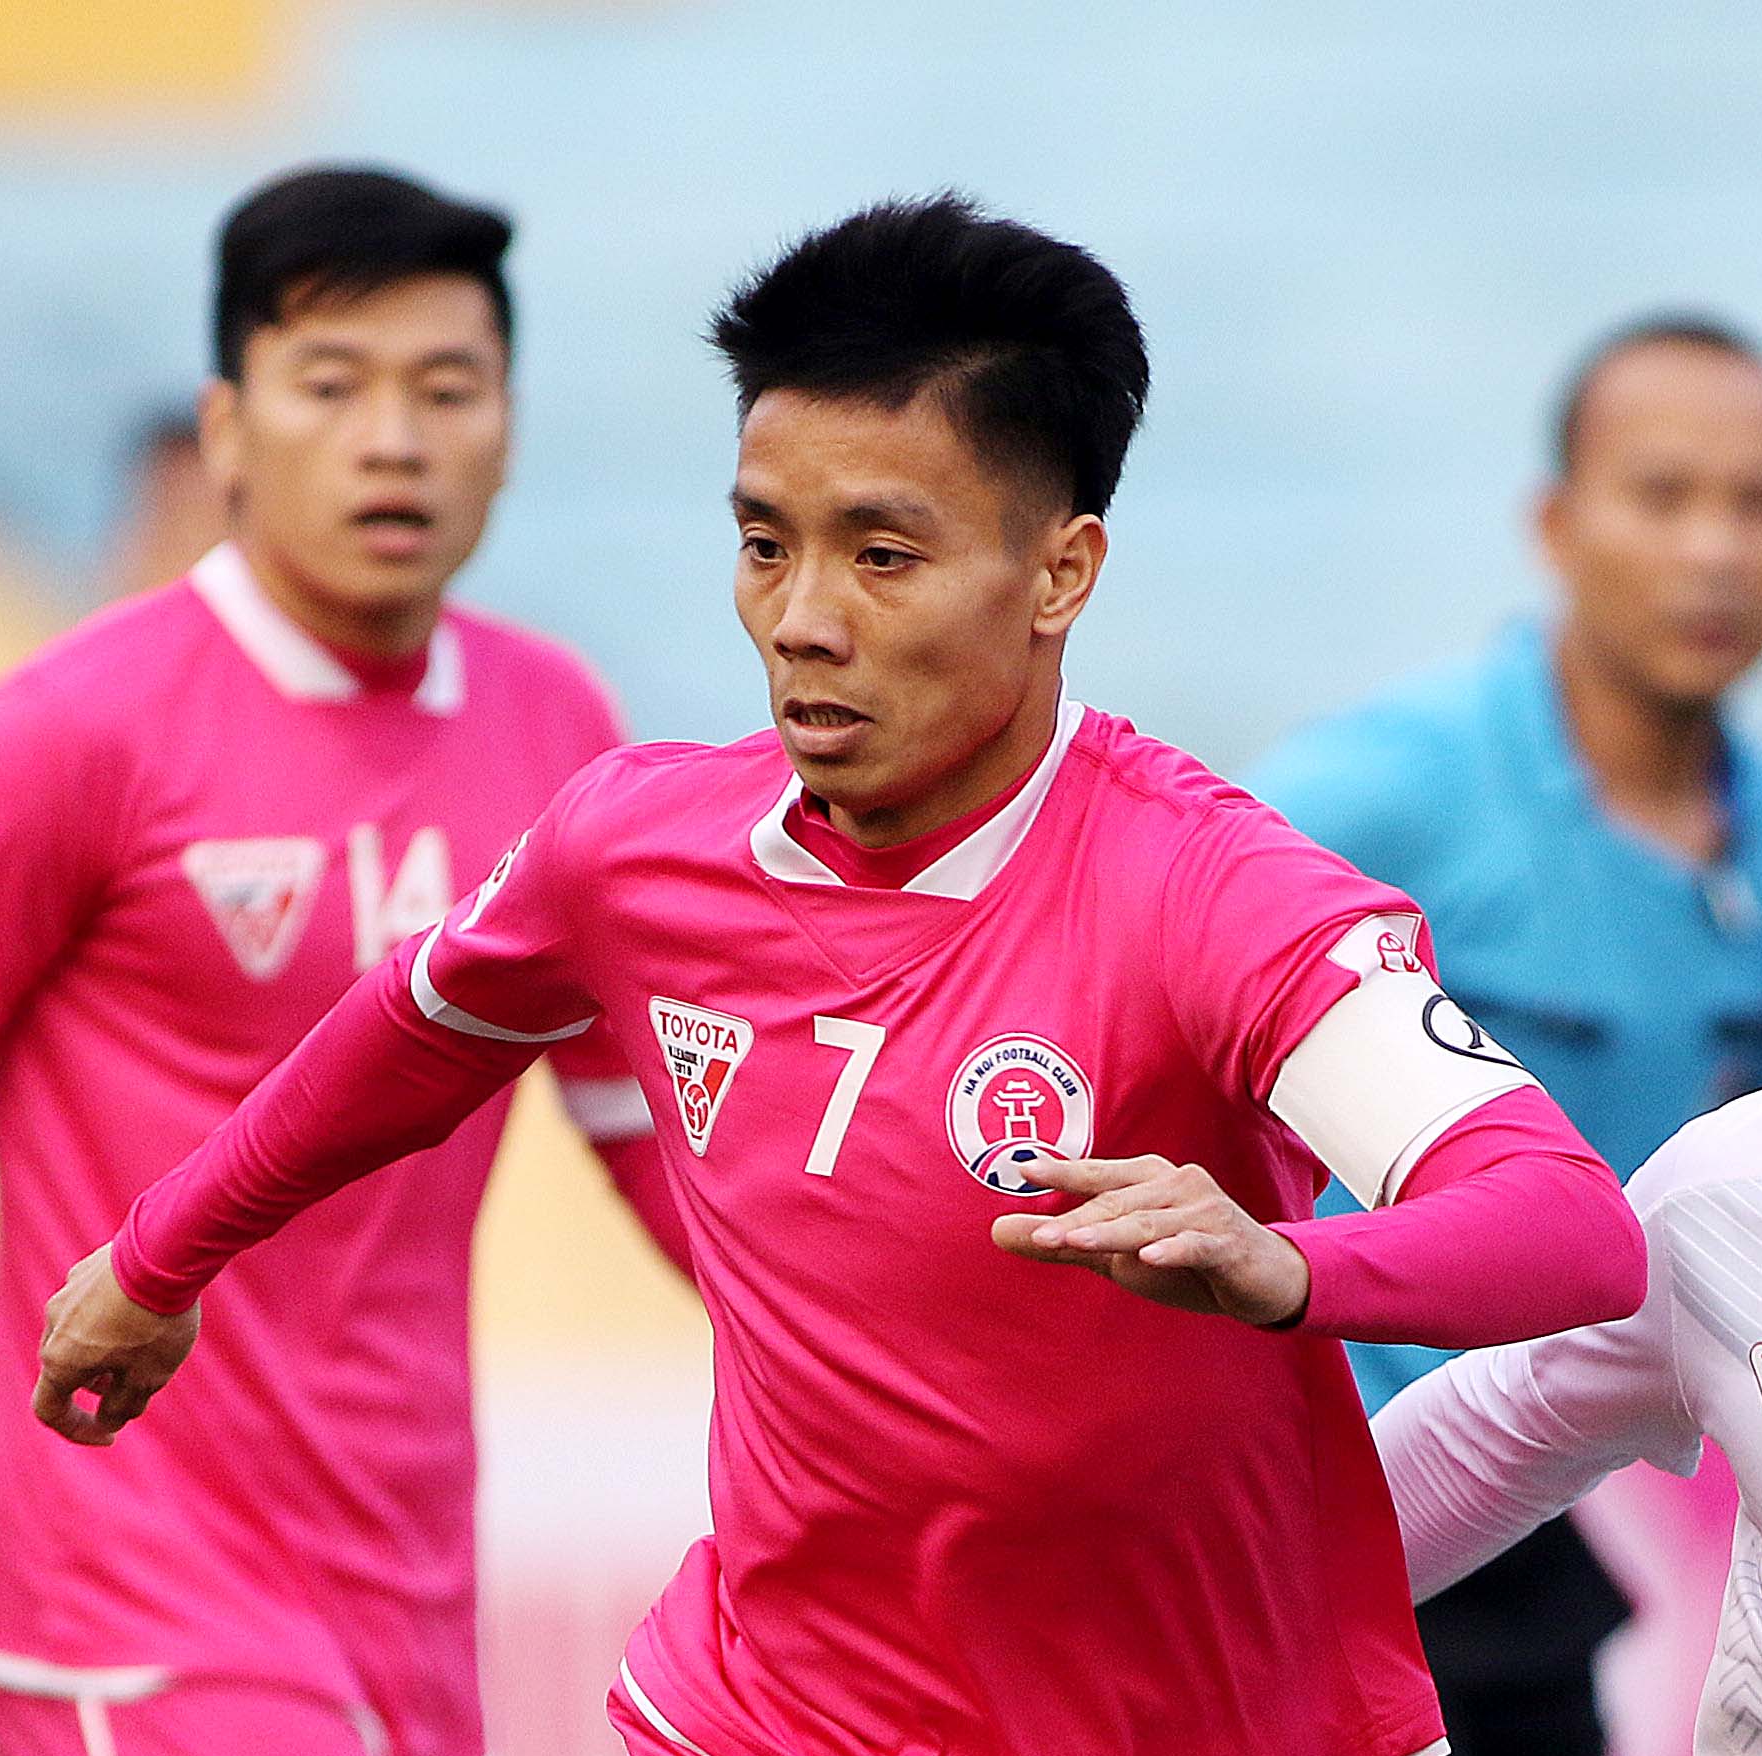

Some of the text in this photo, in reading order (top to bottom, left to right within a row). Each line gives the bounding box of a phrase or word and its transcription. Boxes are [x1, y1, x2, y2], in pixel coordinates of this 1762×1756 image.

[348, 772, 454, 974] 14
[658, 1010, 738, 1054] TOYOTA
[963, 1047, 1078, 1097] HA NOI FOOTBALL CLUB
[804, 1014, 887, 1178] 7
